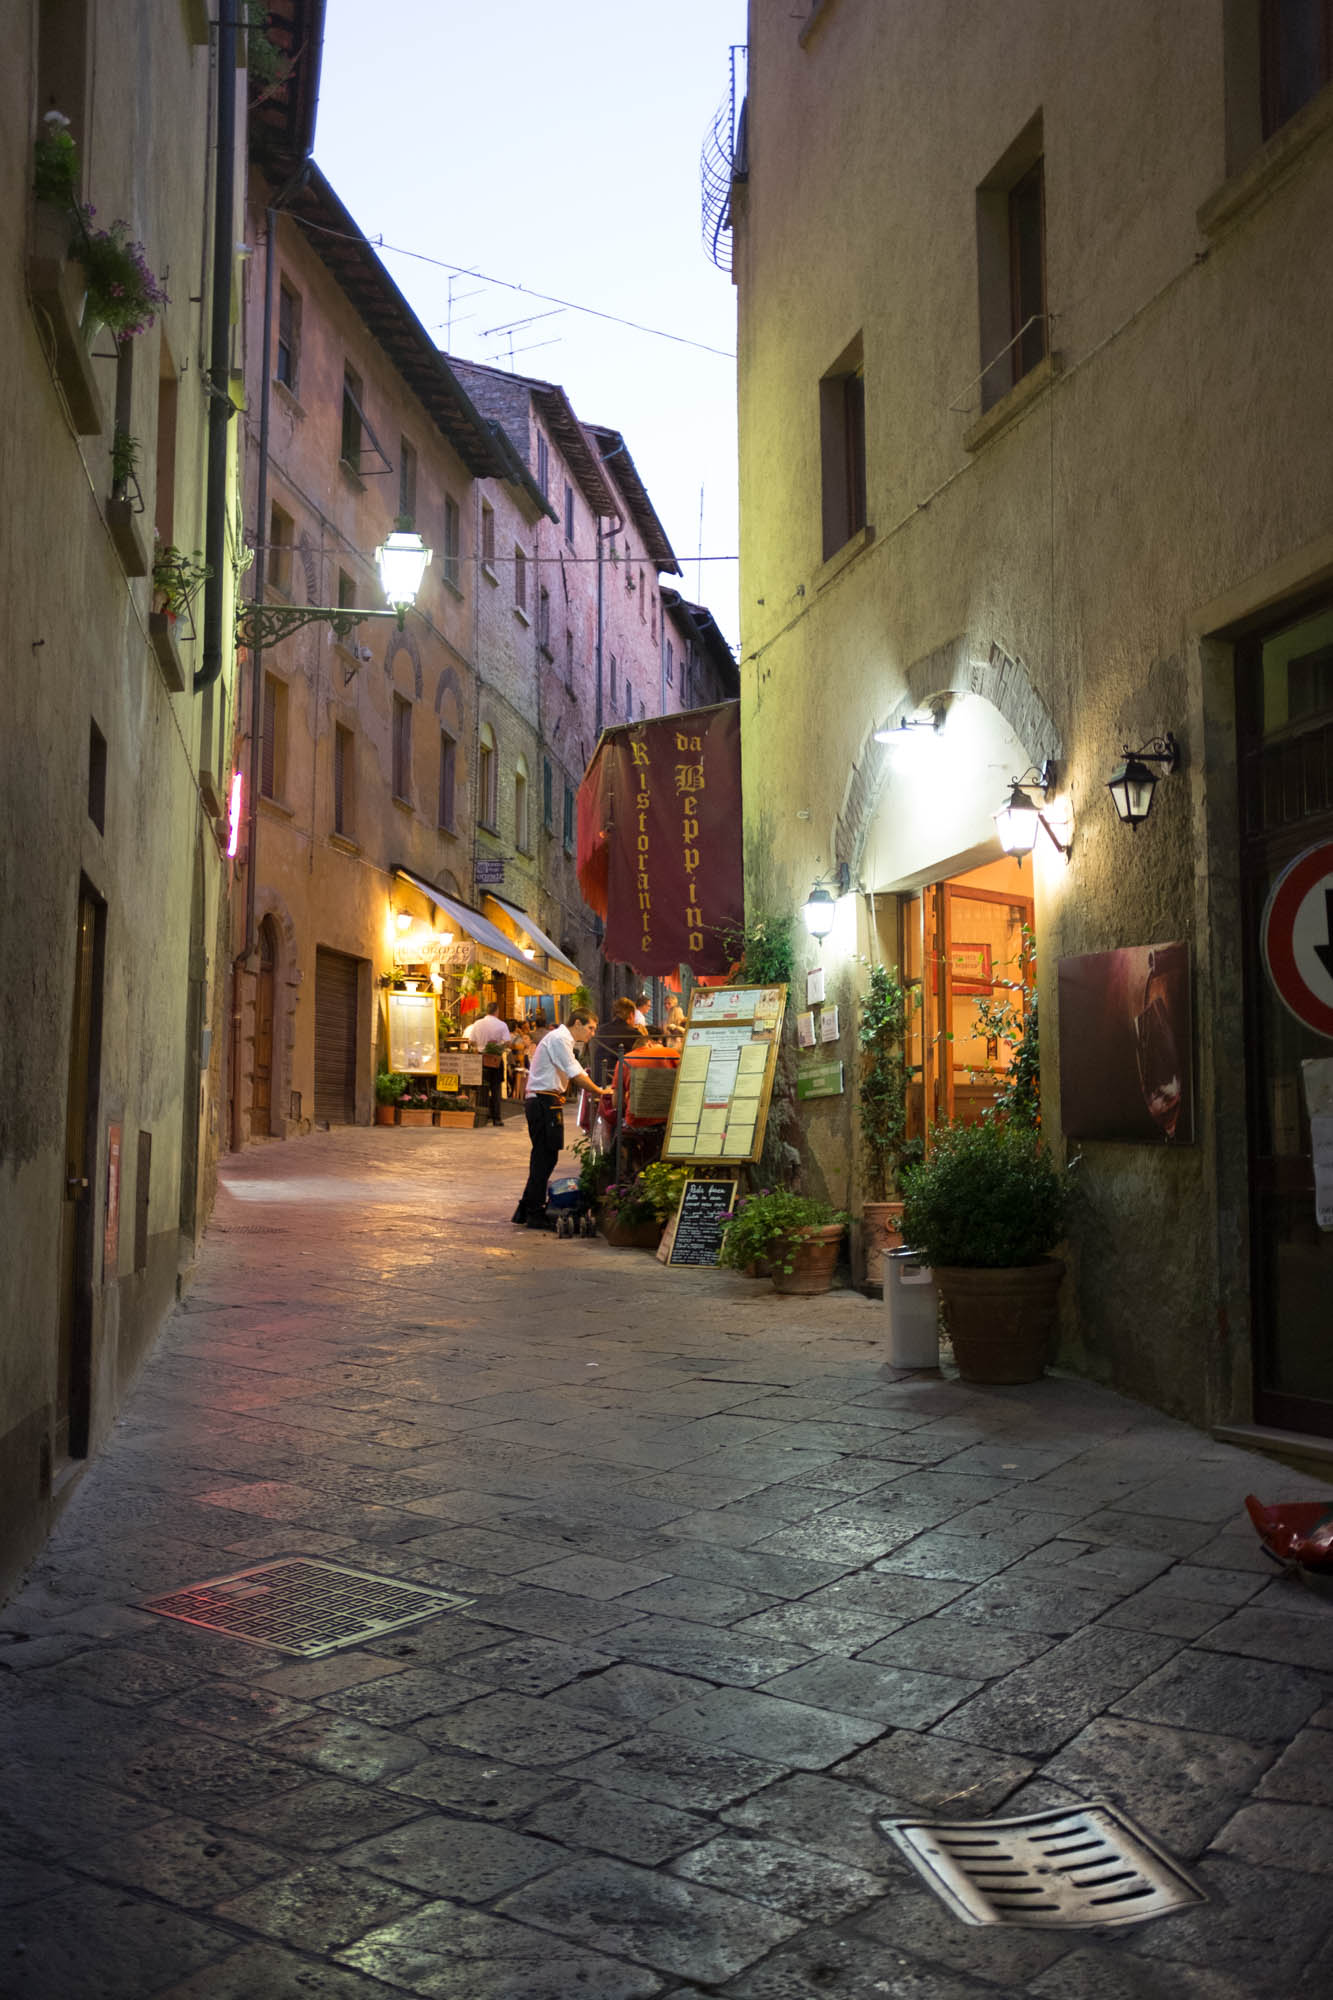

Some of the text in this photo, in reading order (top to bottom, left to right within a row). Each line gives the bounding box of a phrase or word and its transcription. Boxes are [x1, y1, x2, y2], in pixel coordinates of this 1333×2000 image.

[676, 732, 702, 752] da
[631, 741, 651, 952] Ristorante
[674, 763, 705, 952] Beppino
